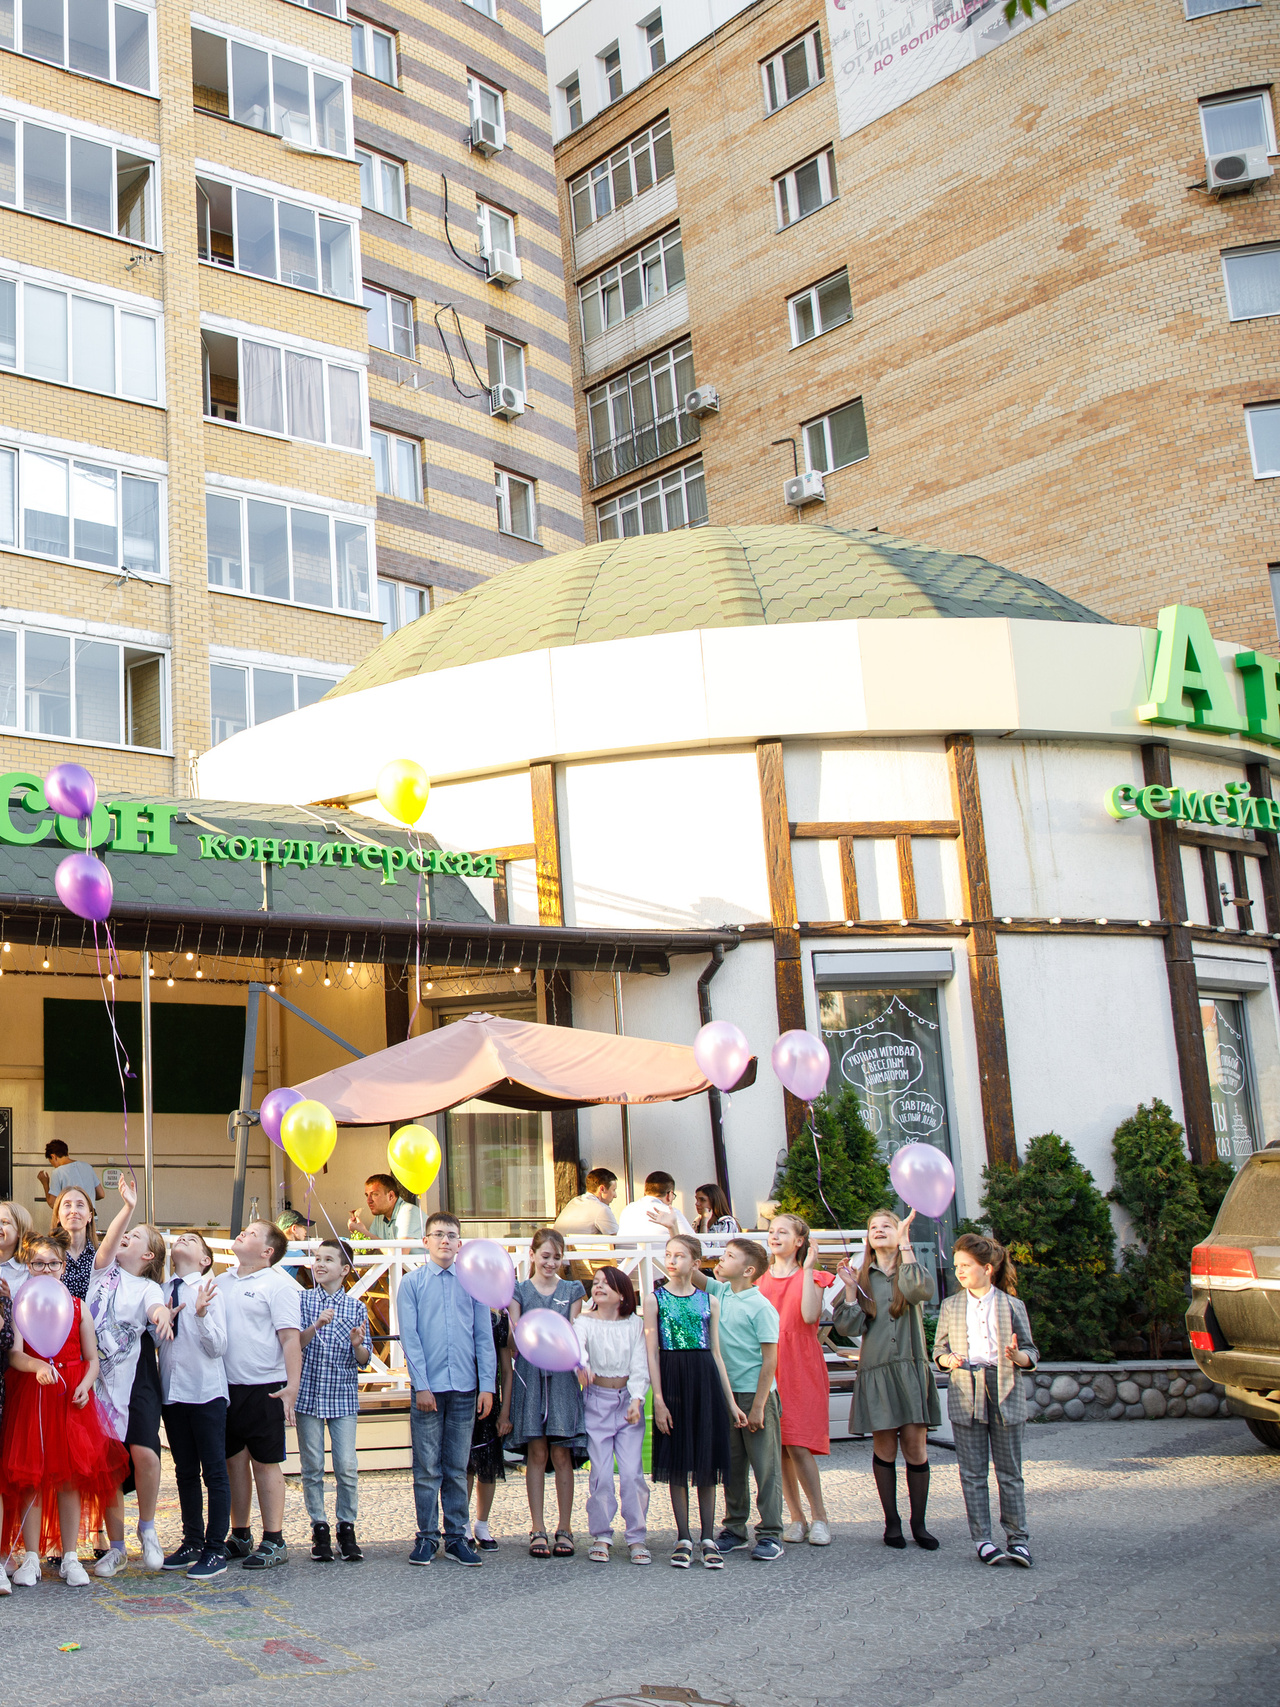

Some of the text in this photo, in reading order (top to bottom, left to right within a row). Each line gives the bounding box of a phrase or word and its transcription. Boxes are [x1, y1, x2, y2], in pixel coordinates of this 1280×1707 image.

[873, 54, 893, 75] ДО
[900, 0, 990, 56] ВОПЛОЩЕН
[198, 833, 500, 886] кондитерская
[847, 1045, 915, 1067] УЮТНАЯ ИГРОВАЯ
[867, 1057, 904, 1073] ВЕСЕЛЫМ
[865, 1069, 909, 1086] АНИМАТОРОМ
[899, 1100, 937, 1115] ЗАВТРАК
[898, 1112, 937, 1128] ЦЕЛЫЙ ДЕНЬ
